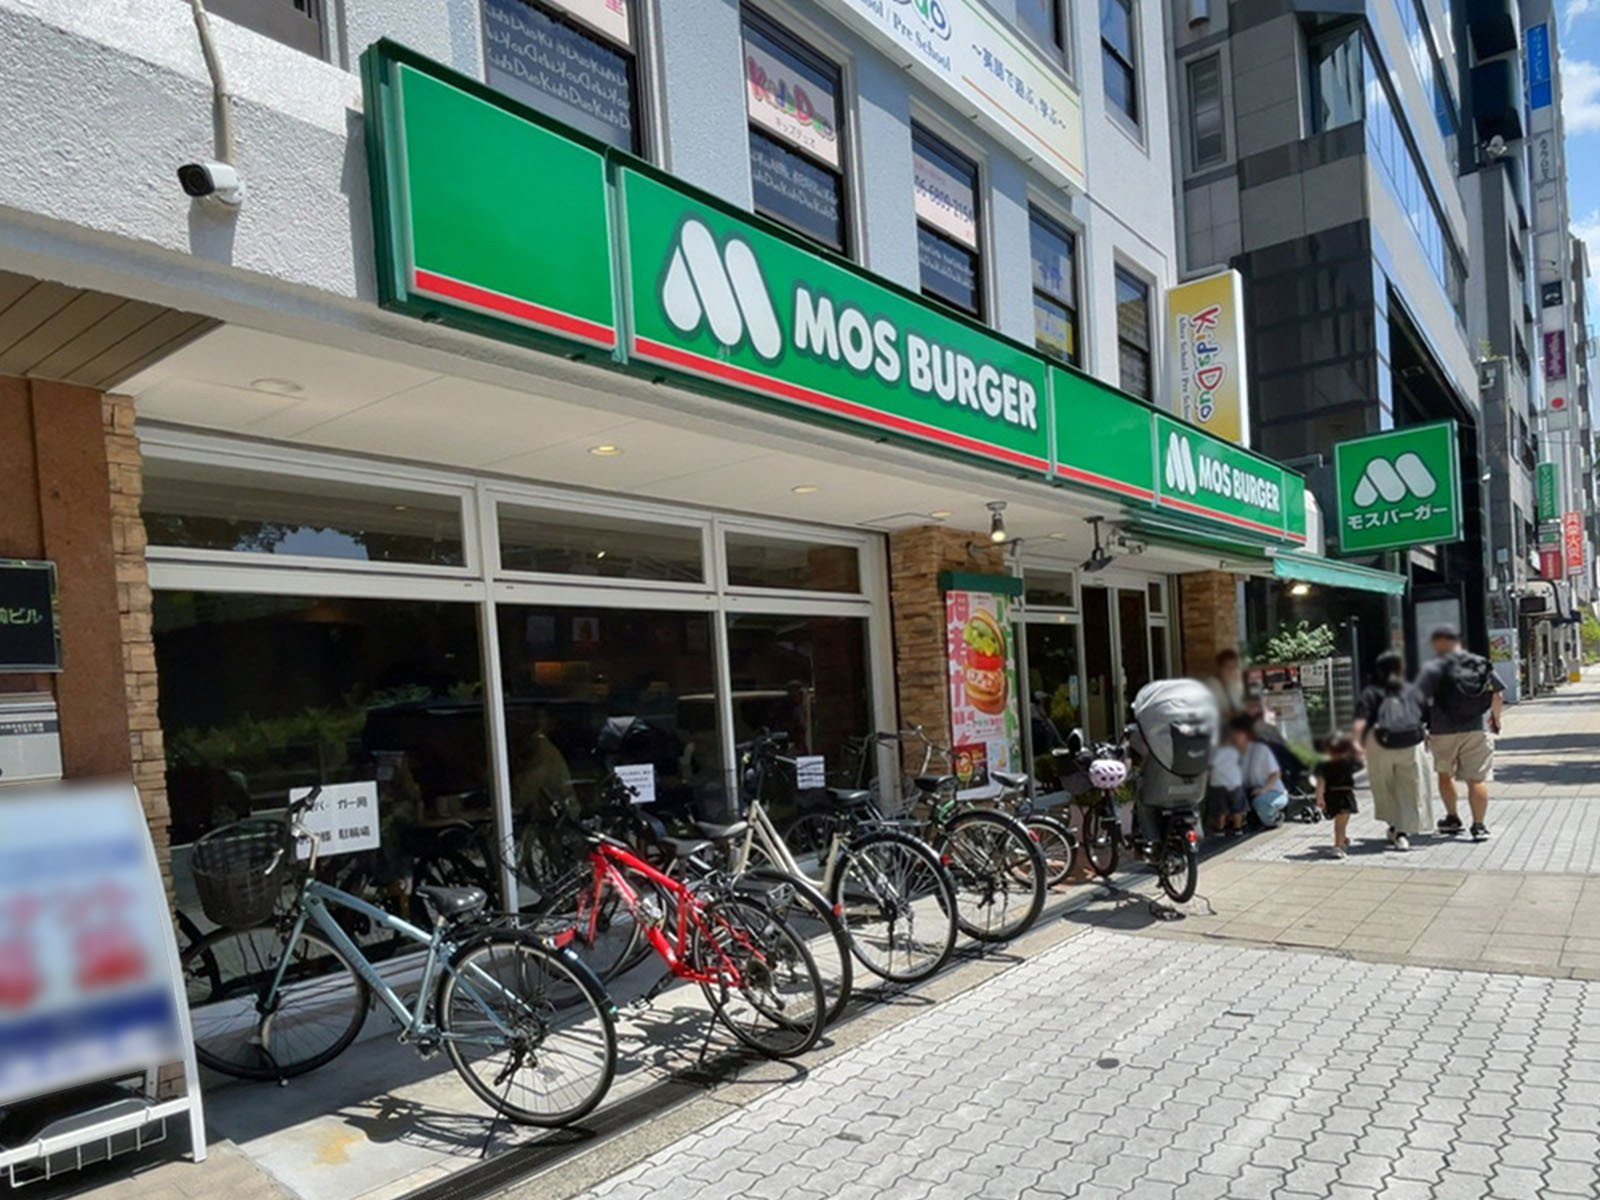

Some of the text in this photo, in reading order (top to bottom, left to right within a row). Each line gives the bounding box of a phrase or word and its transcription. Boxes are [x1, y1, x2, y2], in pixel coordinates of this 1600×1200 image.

[893, 12, 913, 41] Pre
[915, 31, 951, 71] School
[793, 287, 1038, 430] MOS BURGER
[1193, 307, 1223, 419] KidsDuo
[1198, 454, 1281, 513] MOS BURGER
[1347, 503, 1448, 530] モスバーガー
